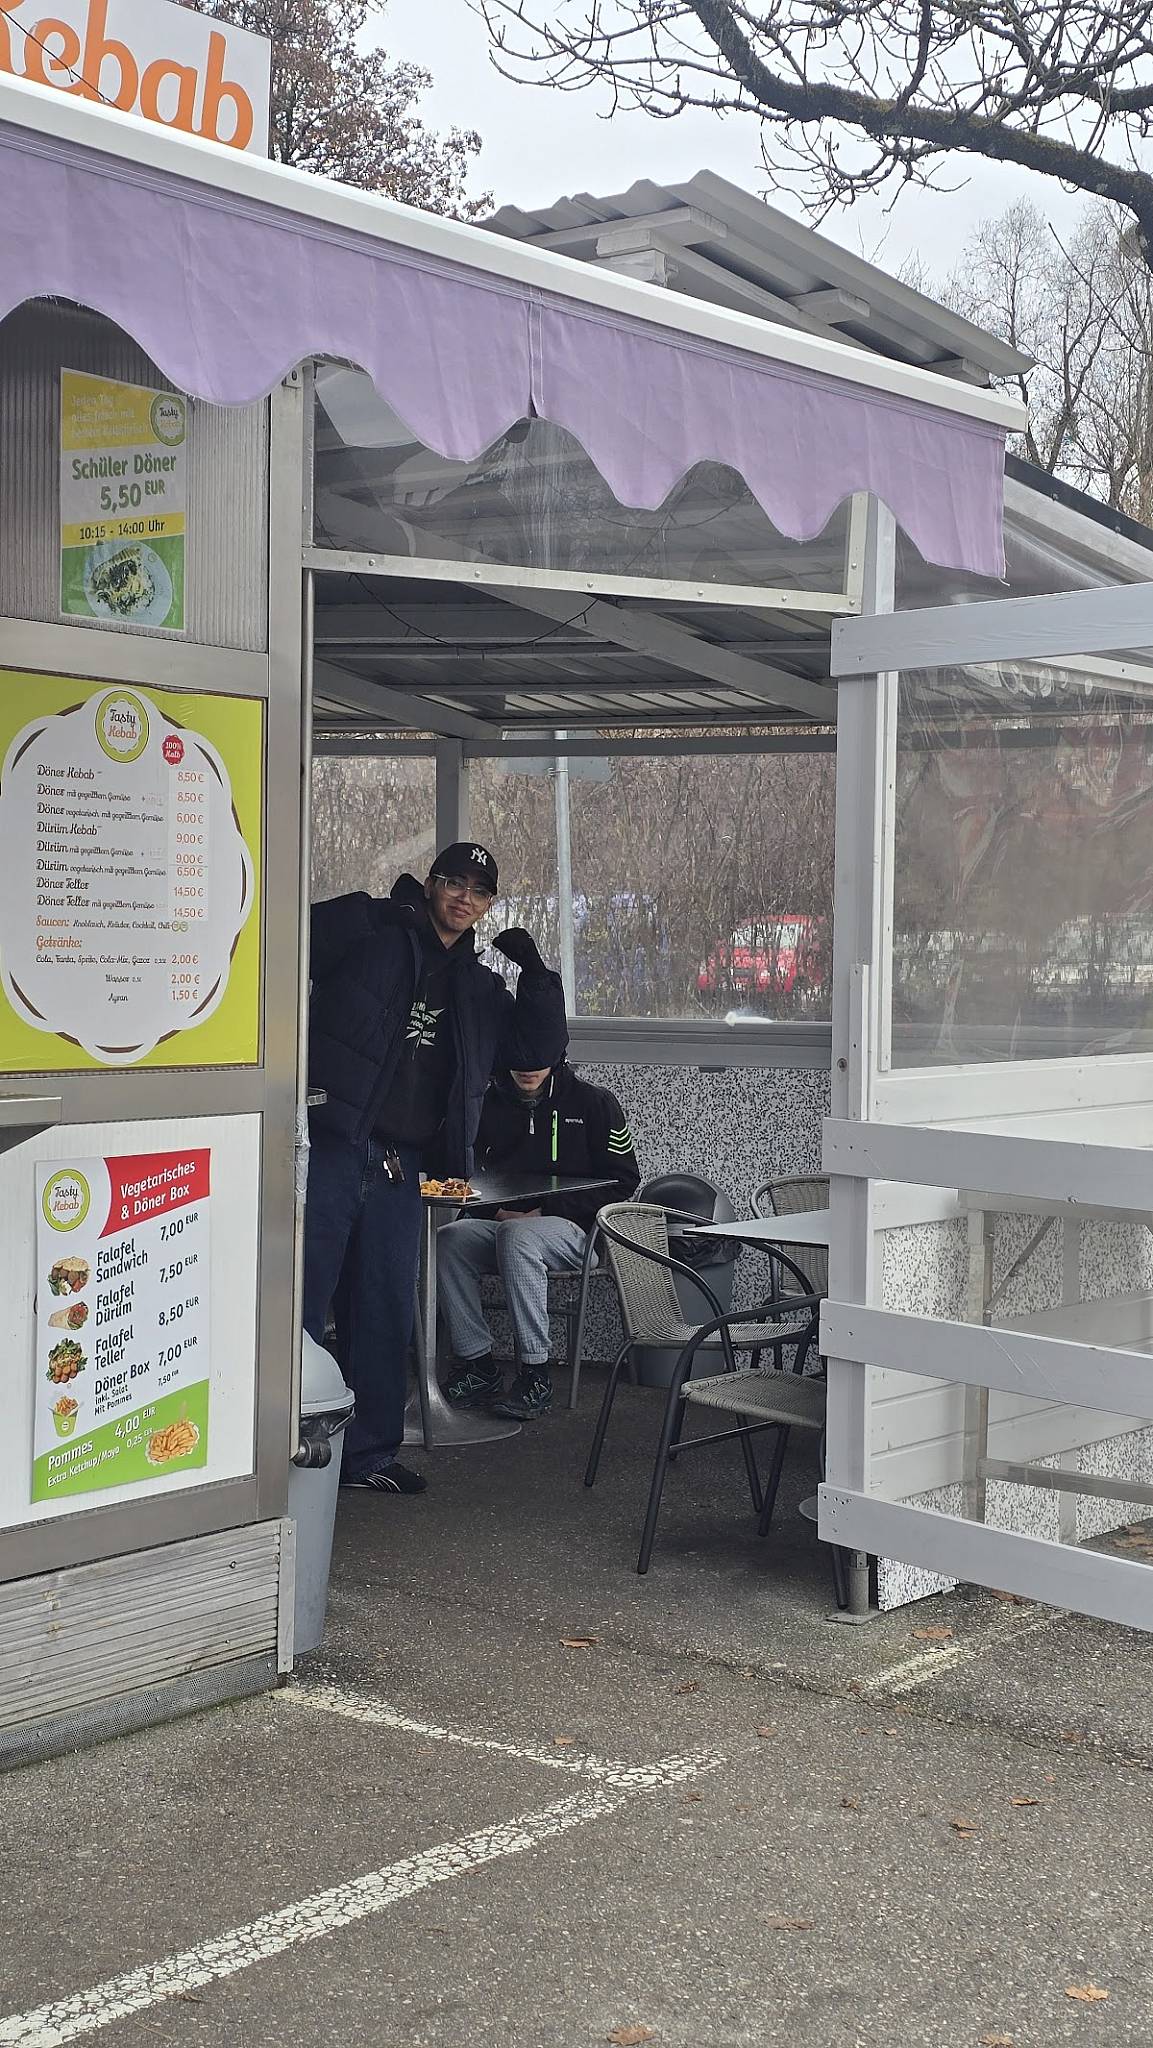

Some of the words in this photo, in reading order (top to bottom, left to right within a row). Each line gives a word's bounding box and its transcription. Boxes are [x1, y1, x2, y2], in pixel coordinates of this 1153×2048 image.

[160, 406, 179, 419] Tasty
[72, 456, 128, 480] Schüler
[134, 453, 177, 474] Döner
[100, 483, 141, 513] 5,50
[145, 480, 165, 495] EUR
[80, 526, 105, 540] 10:15
[118, 521, 145, 535] 14:00
[148, 519, 165, 532] Uhr
[110, 709, 136, 727] Tasty
[108, 725, 137, 739] Kebab
[165, 742, 181, 751] 100%
[37, 764, 65, 777] Döner
[66, 766, 95, 780] Kebab
[37, 783, 65, 796] Döner
[37, 802, 65, 815] Döner
[37, 821, 68, 834] Dürüm
[70, 823, 97, 836] Kebab
[37, 840, 69, 853] Dürüm
[36, 859, 68, 872] Dürüm
[36, 876, 64, 889] Döner
[65, 877, 89, 890] Teller
[37, 894, 65, 906] Döner
[66, 895, 90, 907] Teller
[36, 914, 70, 927] Saucen:
[36, 935, 82, 950] Getränke:
[36, 954, 53, 964] Cola,
[171, 954, 191, 965] 2,00
[192, 955, 199, 965] €
[171, 974, 191, 985] 2,00
[194, 974, 200, 984] €
[108, 993, 129, 1004] Ayran
[192, 989, 198, 999] €
[120, 1161, 196, 1199] Vegetarisches
[54, 1185, 79, 1199] Tasty
[53, 1198, 80, 1212] Kebab
[120, 1205, 130, 1220] &
[133, 1193, 166, 1215] Döner
[170, 1184, 190, 1201] Box
[160, 1219, 184, 1241] 7,00
[185, 1212, 199, 1224] EUR
[97, 1238, 135, 1267] Falafel
[96, 1249, 148, 1283] Sandwich
[159, 1261, 183, 1283] 7,50
[184, 1254, 198, 1266] EUR
[96, 1280, 134, 1310] Falafel
[95, 1301, 132, 1327] Dürüm
[158, 1303, 183, 1326] 8,50
[185, 1296, 199, 1308] EUR
[95, 1324, 134, 1354] Falafel
[158, 1344, 182, 1366] 7,00
[184, 1336, 198, 1348] EUR
[94, 1347, 125, 1371] Teller
[95, 1370, 128, 1395] Döner
[130, 1360, 150, 1379] Box
[158, 1373, 171, 1386] 7,50
[111, 1384, 128, 1398] Salat
[94, 1405, 105, 1416] Mit
[107, 1393, 132, 1410] Pommes
[115, 1415, 140, 1439] 4,00
[142, 1407, 156, 1420] EUR
[48, 1440, 94, 1471] Pommes
[48, 1474, 67, 1488] Extra
